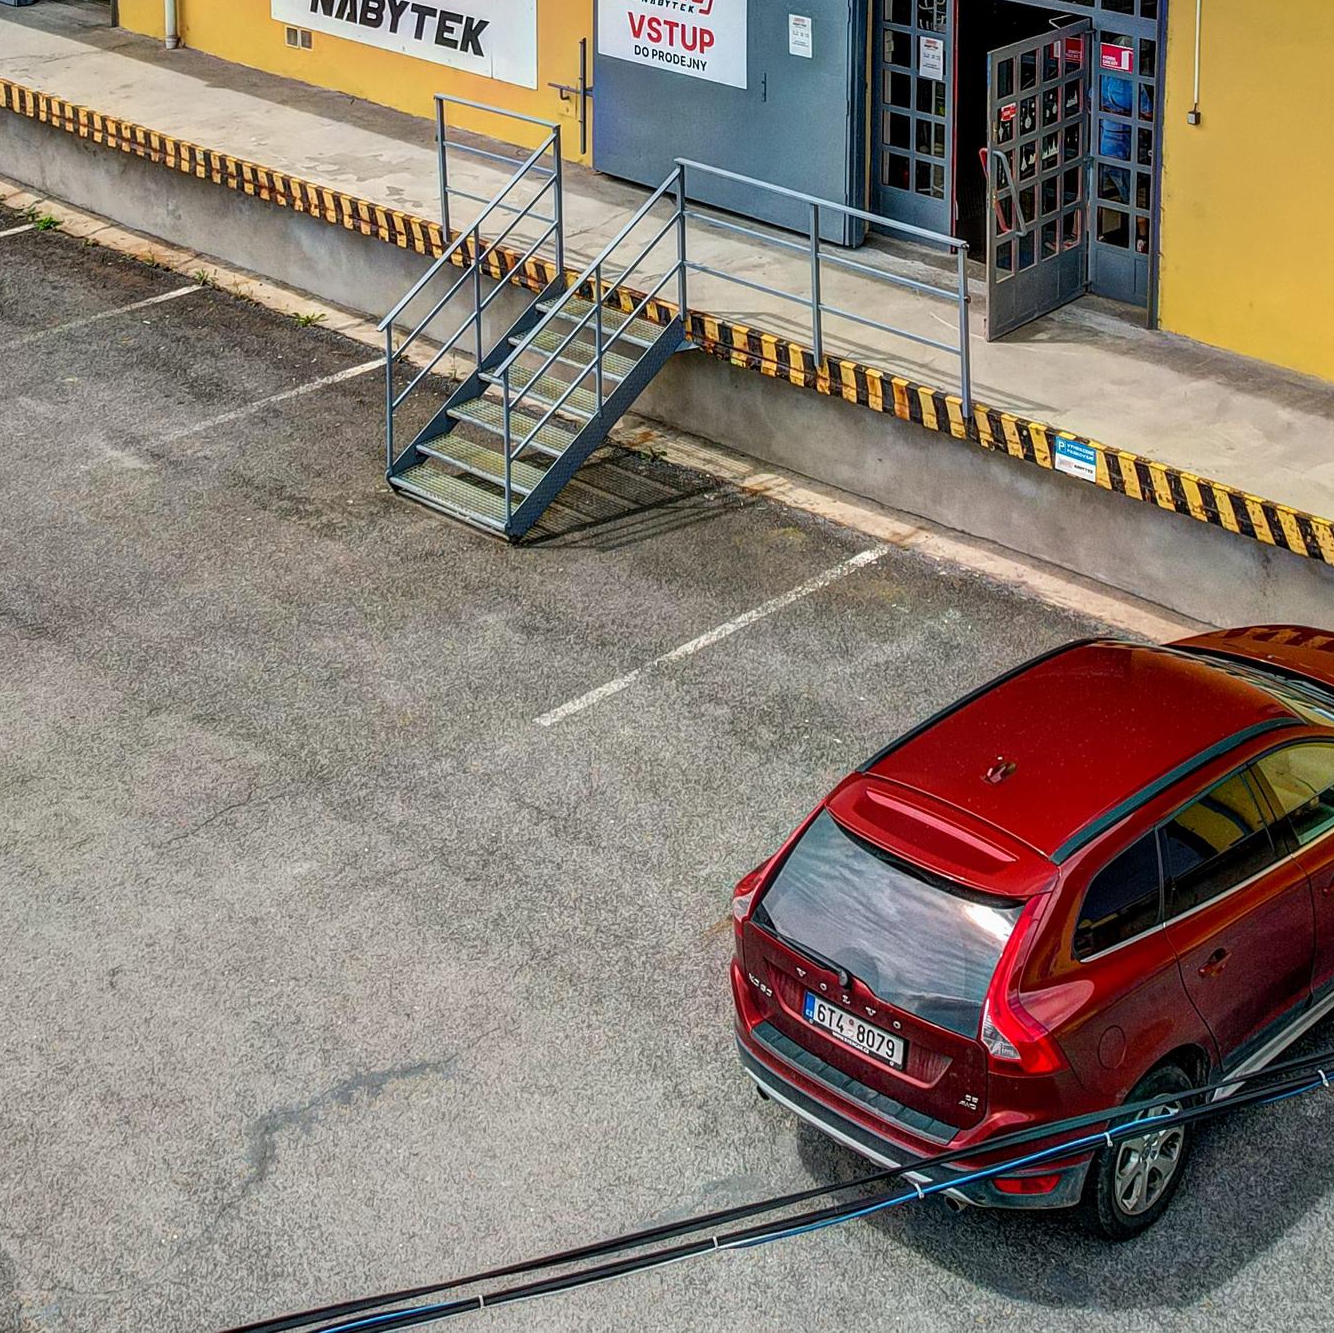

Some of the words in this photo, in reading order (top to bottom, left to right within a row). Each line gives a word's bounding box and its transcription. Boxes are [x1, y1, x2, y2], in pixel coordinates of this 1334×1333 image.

[627, 11, 715, 54] VSTUP
[634, 44, 650, 58] DO
[651, 48, 708, 72] PRODEJNY
[796, 967, 902, 1029] VOLVO
[817, 1003, 845, 1033] 6T4
[856, 1024, 895, 1058] 8079
